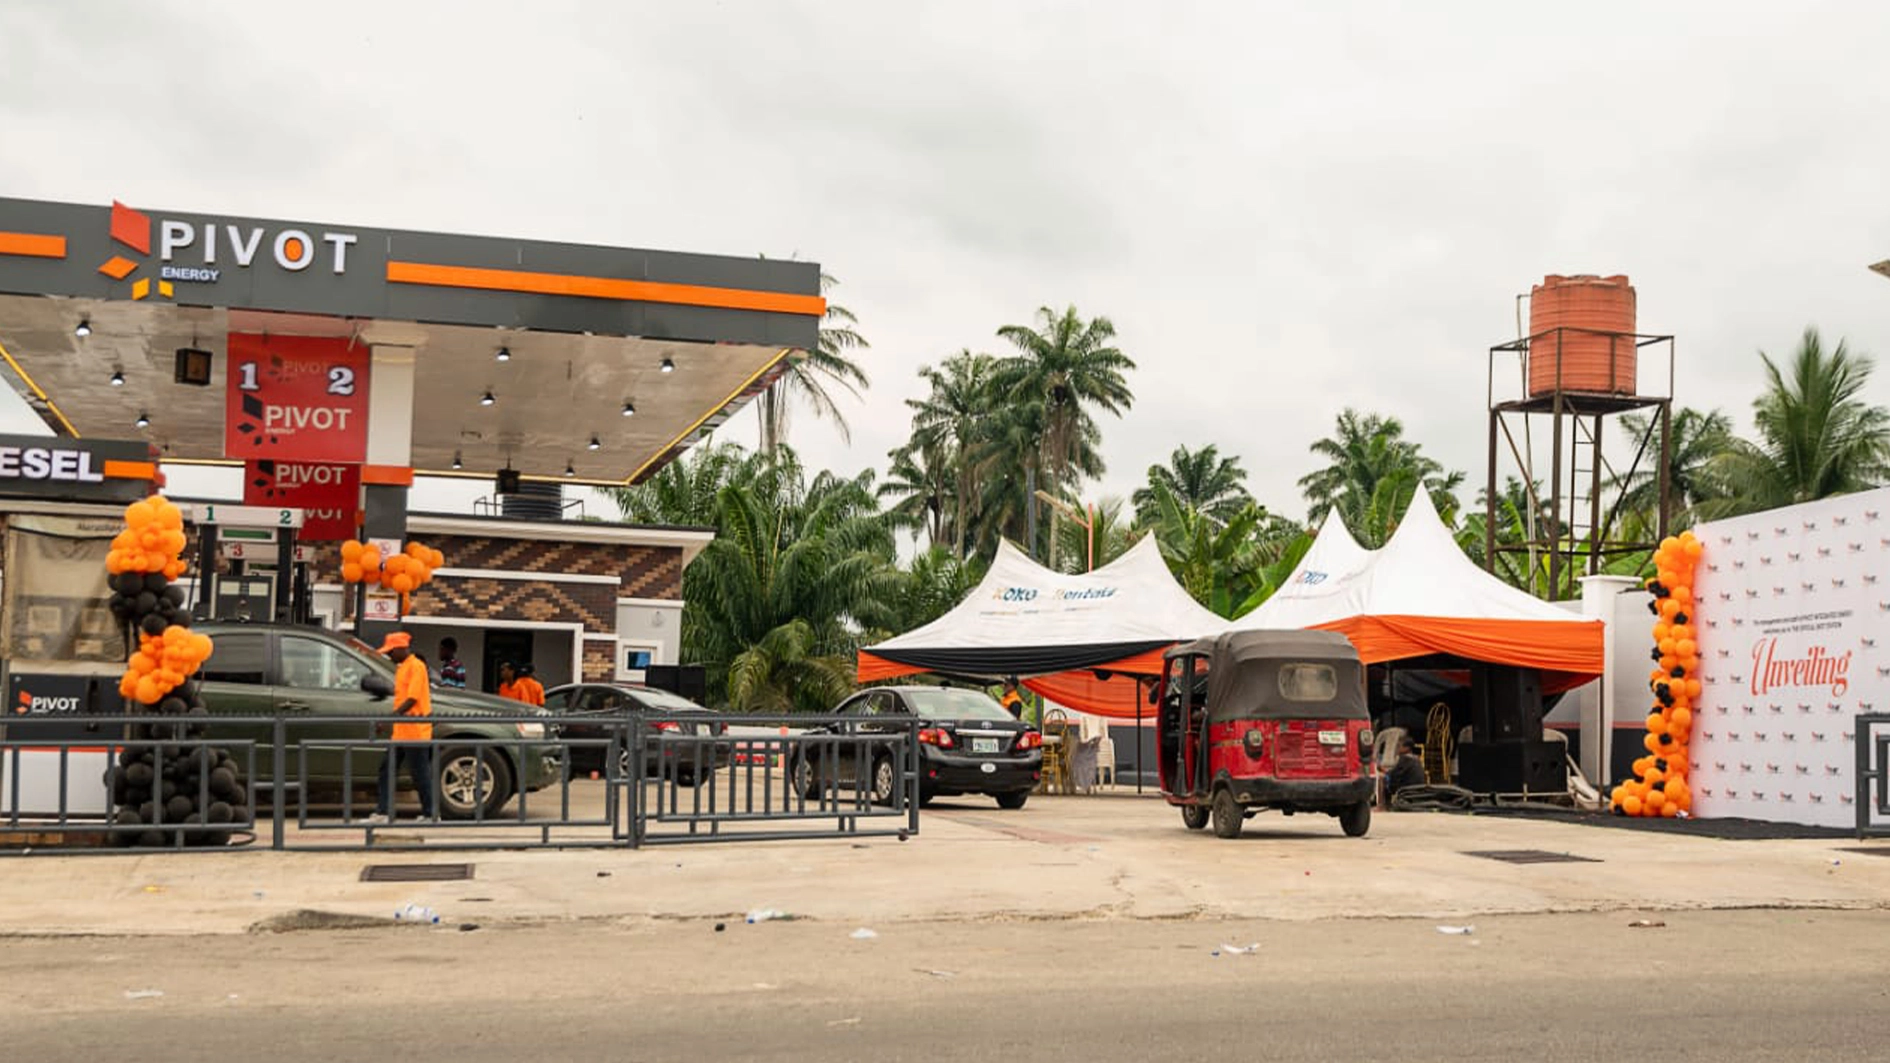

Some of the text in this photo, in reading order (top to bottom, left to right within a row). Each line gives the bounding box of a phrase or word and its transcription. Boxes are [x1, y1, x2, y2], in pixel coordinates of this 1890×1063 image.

[160, 220, 357, 273] PIVOT
[161, 266, 219, 281] ENERGY
[238, 361, 355, 396] 1 2
[265, 405, 352, 430] PIVOT
[275, 463, 346, 485] PIVOT
[206, 505, 292, 524] 1 2
[1751, 637, 1852, 697] Unveiling
[32, 696, 80, 711] PIVOT
